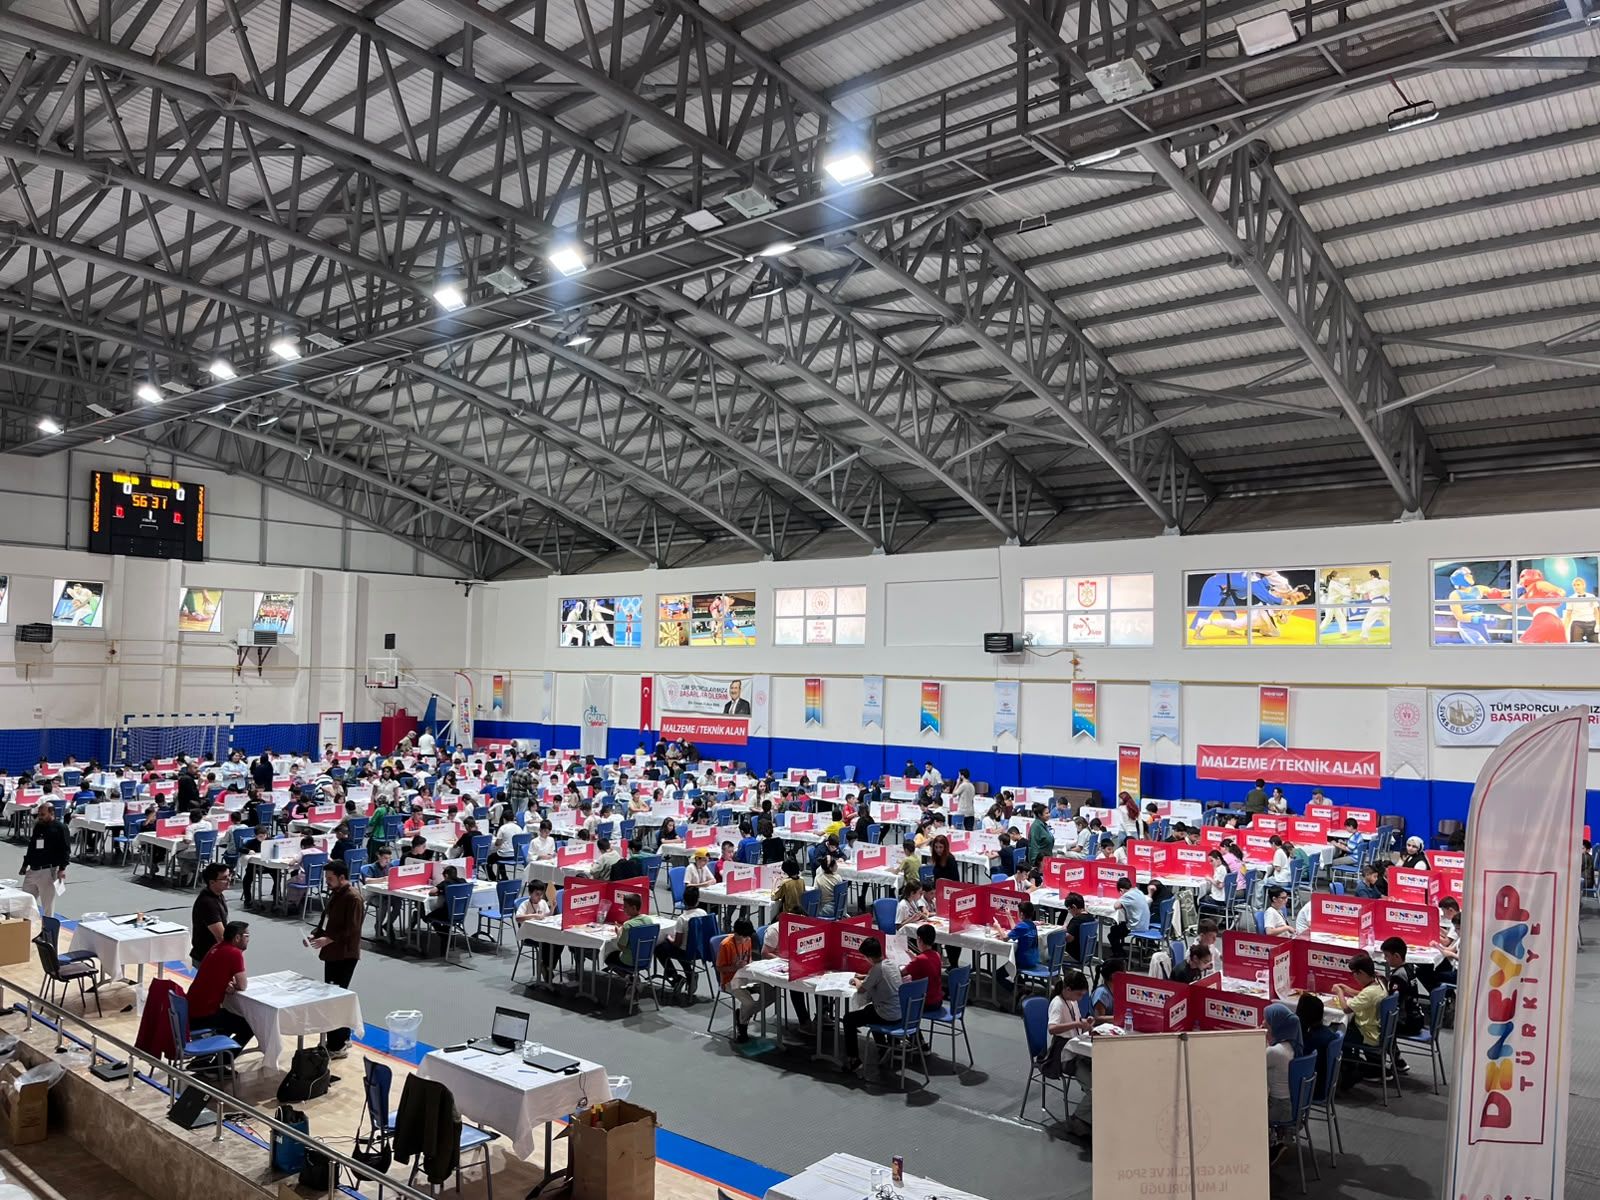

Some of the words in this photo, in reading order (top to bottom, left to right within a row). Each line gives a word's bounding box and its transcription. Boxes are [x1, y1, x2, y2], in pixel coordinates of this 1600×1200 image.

[1490, 702, 1512, 711] TÜM
[662, 723, 695, 733] MALZEME
[724, 726, 746, 736] ALAN
[1201, 755, 1268, 770] MALZEME
[1332, 761, 1375, 775] ALAN
[1239, 943, 1270, 953] DENEYA
[1480, 885, 1530, 1129] DENEYAP
[1516, 923, 1541, 1092] TÜRKİYE
